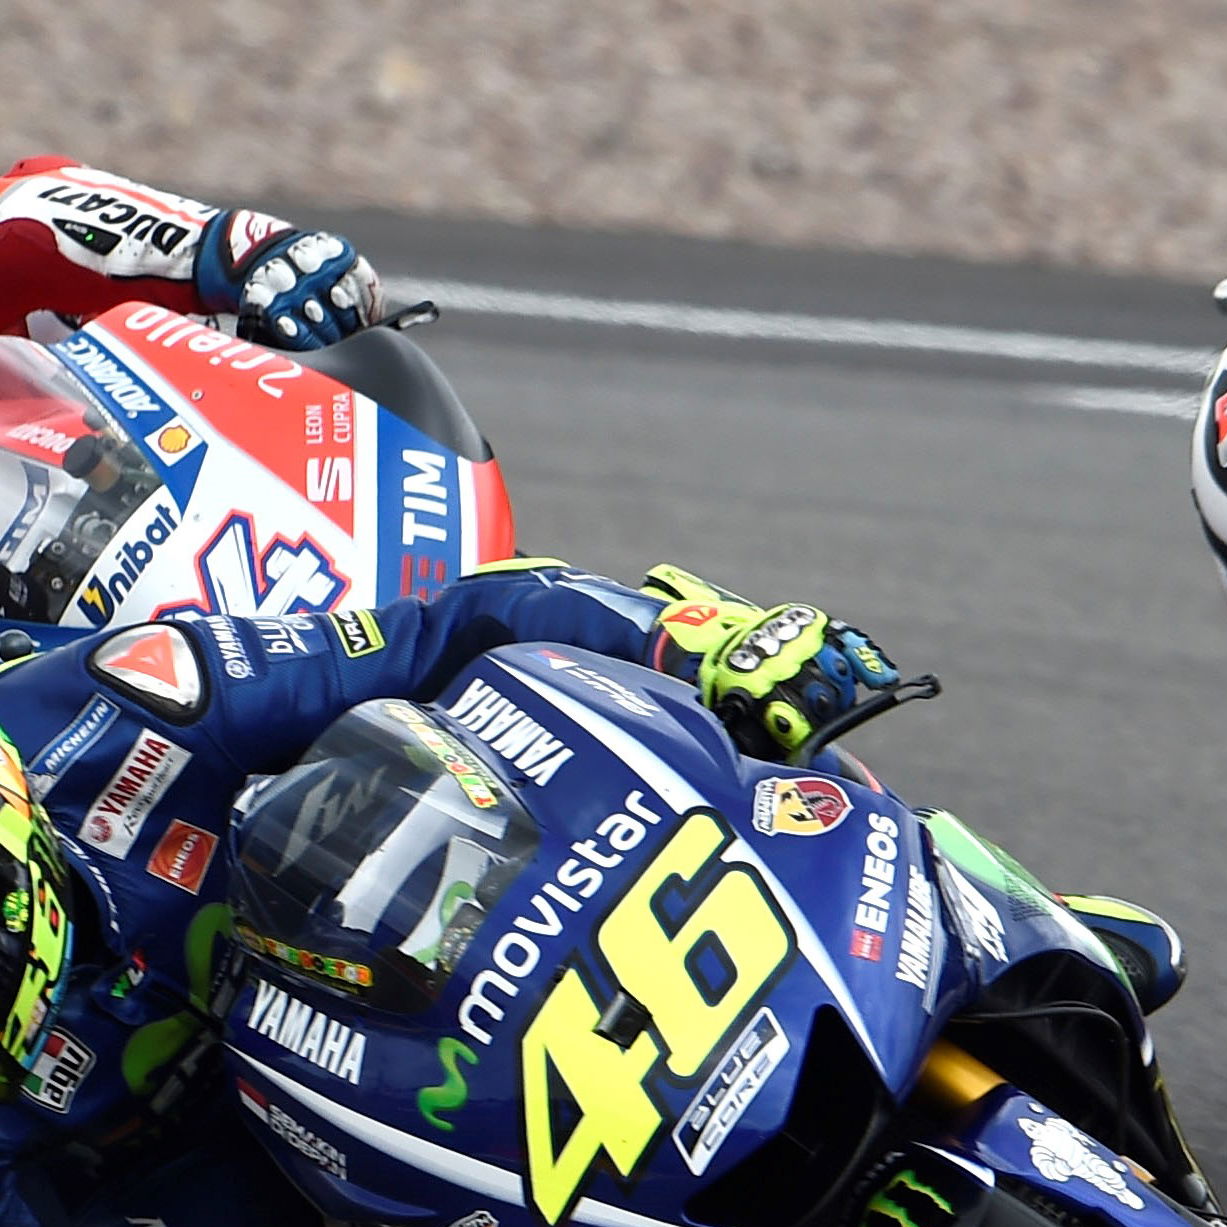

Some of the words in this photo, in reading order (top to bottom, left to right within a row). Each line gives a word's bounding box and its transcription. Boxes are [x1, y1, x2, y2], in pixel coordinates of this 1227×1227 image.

[38, 186, 191, 255] DUCATI
[56, 337, 161, 412] ADVANCE
[332, 391, 351, 443] CUPRA
[305, 404, 324, 445] LEON
[402, 449, 448, 546] TIM
[76, 504, 179, 628] Unibat
[44, 702, 110, 771] MICHELIN
[96, 737, 171, 816] YAMAHA
[446, 677, 575, 787] YAMAHA
[458, 790, 662, 1045] movistar
[854, 812, 898, 933] ENEOS
[895, 864, 933, 990] YAMALUBE
[247, 978, 367, 1086] YAMAHA
[520, 811, 793, 1227] 46
[690, 1031, 762, 1131] BLUE
[702, 1054, 773, 1151] CORE
